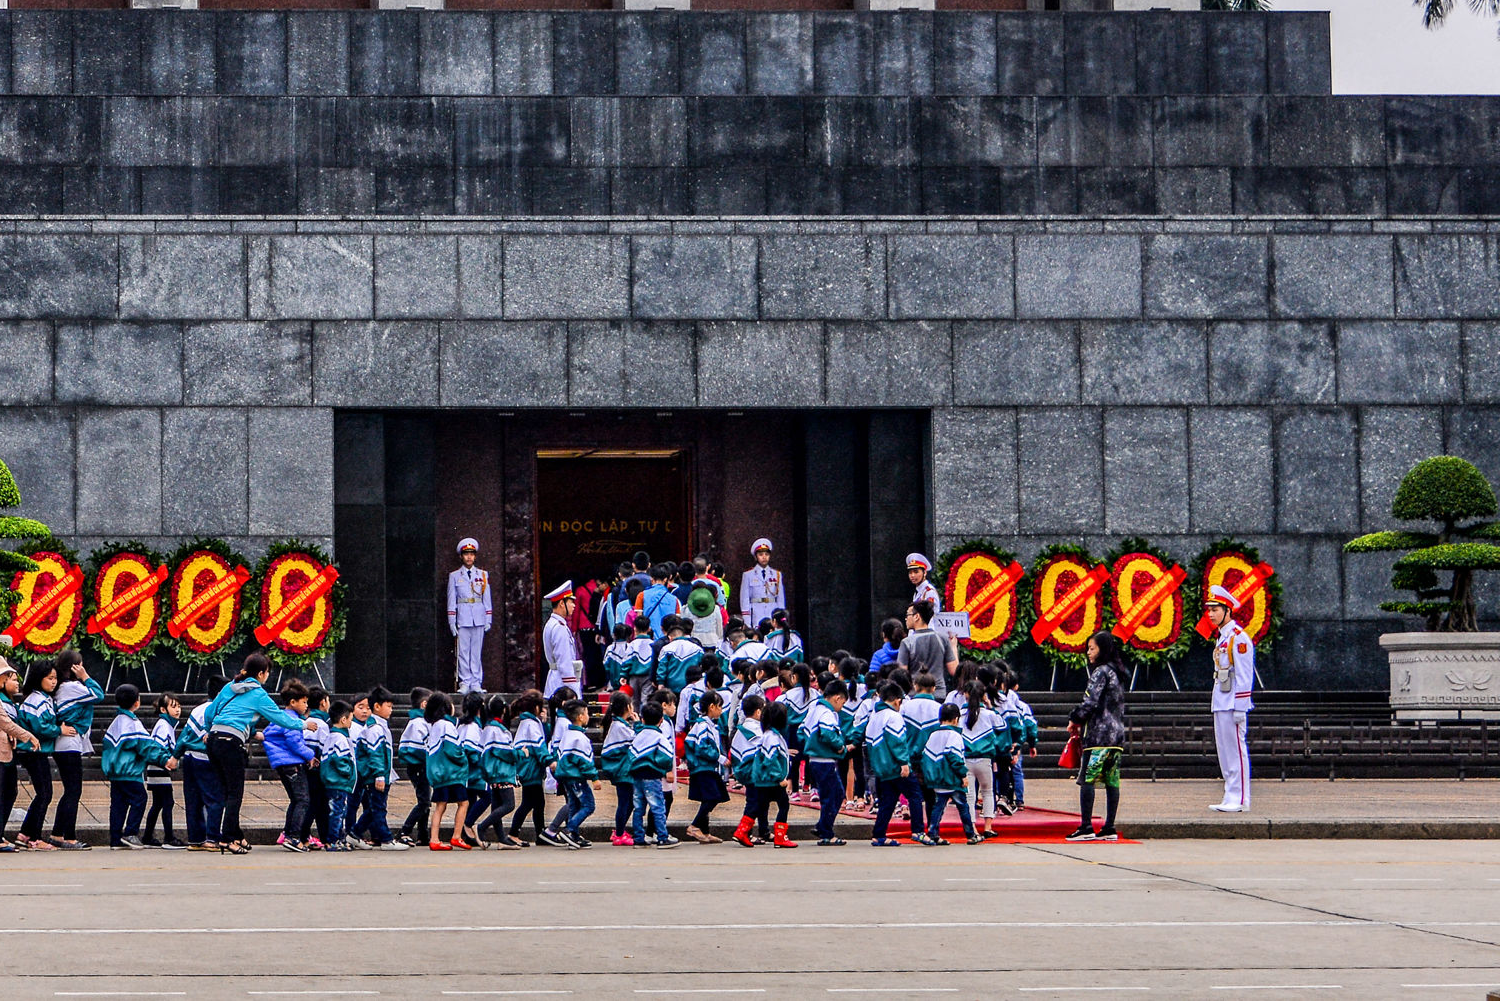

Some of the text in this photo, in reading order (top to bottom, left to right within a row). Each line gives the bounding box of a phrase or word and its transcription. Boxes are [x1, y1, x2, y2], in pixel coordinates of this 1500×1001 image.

[560, 518, 593, 536] ĐỘC
[938, 619, 964, 627] XE 01
